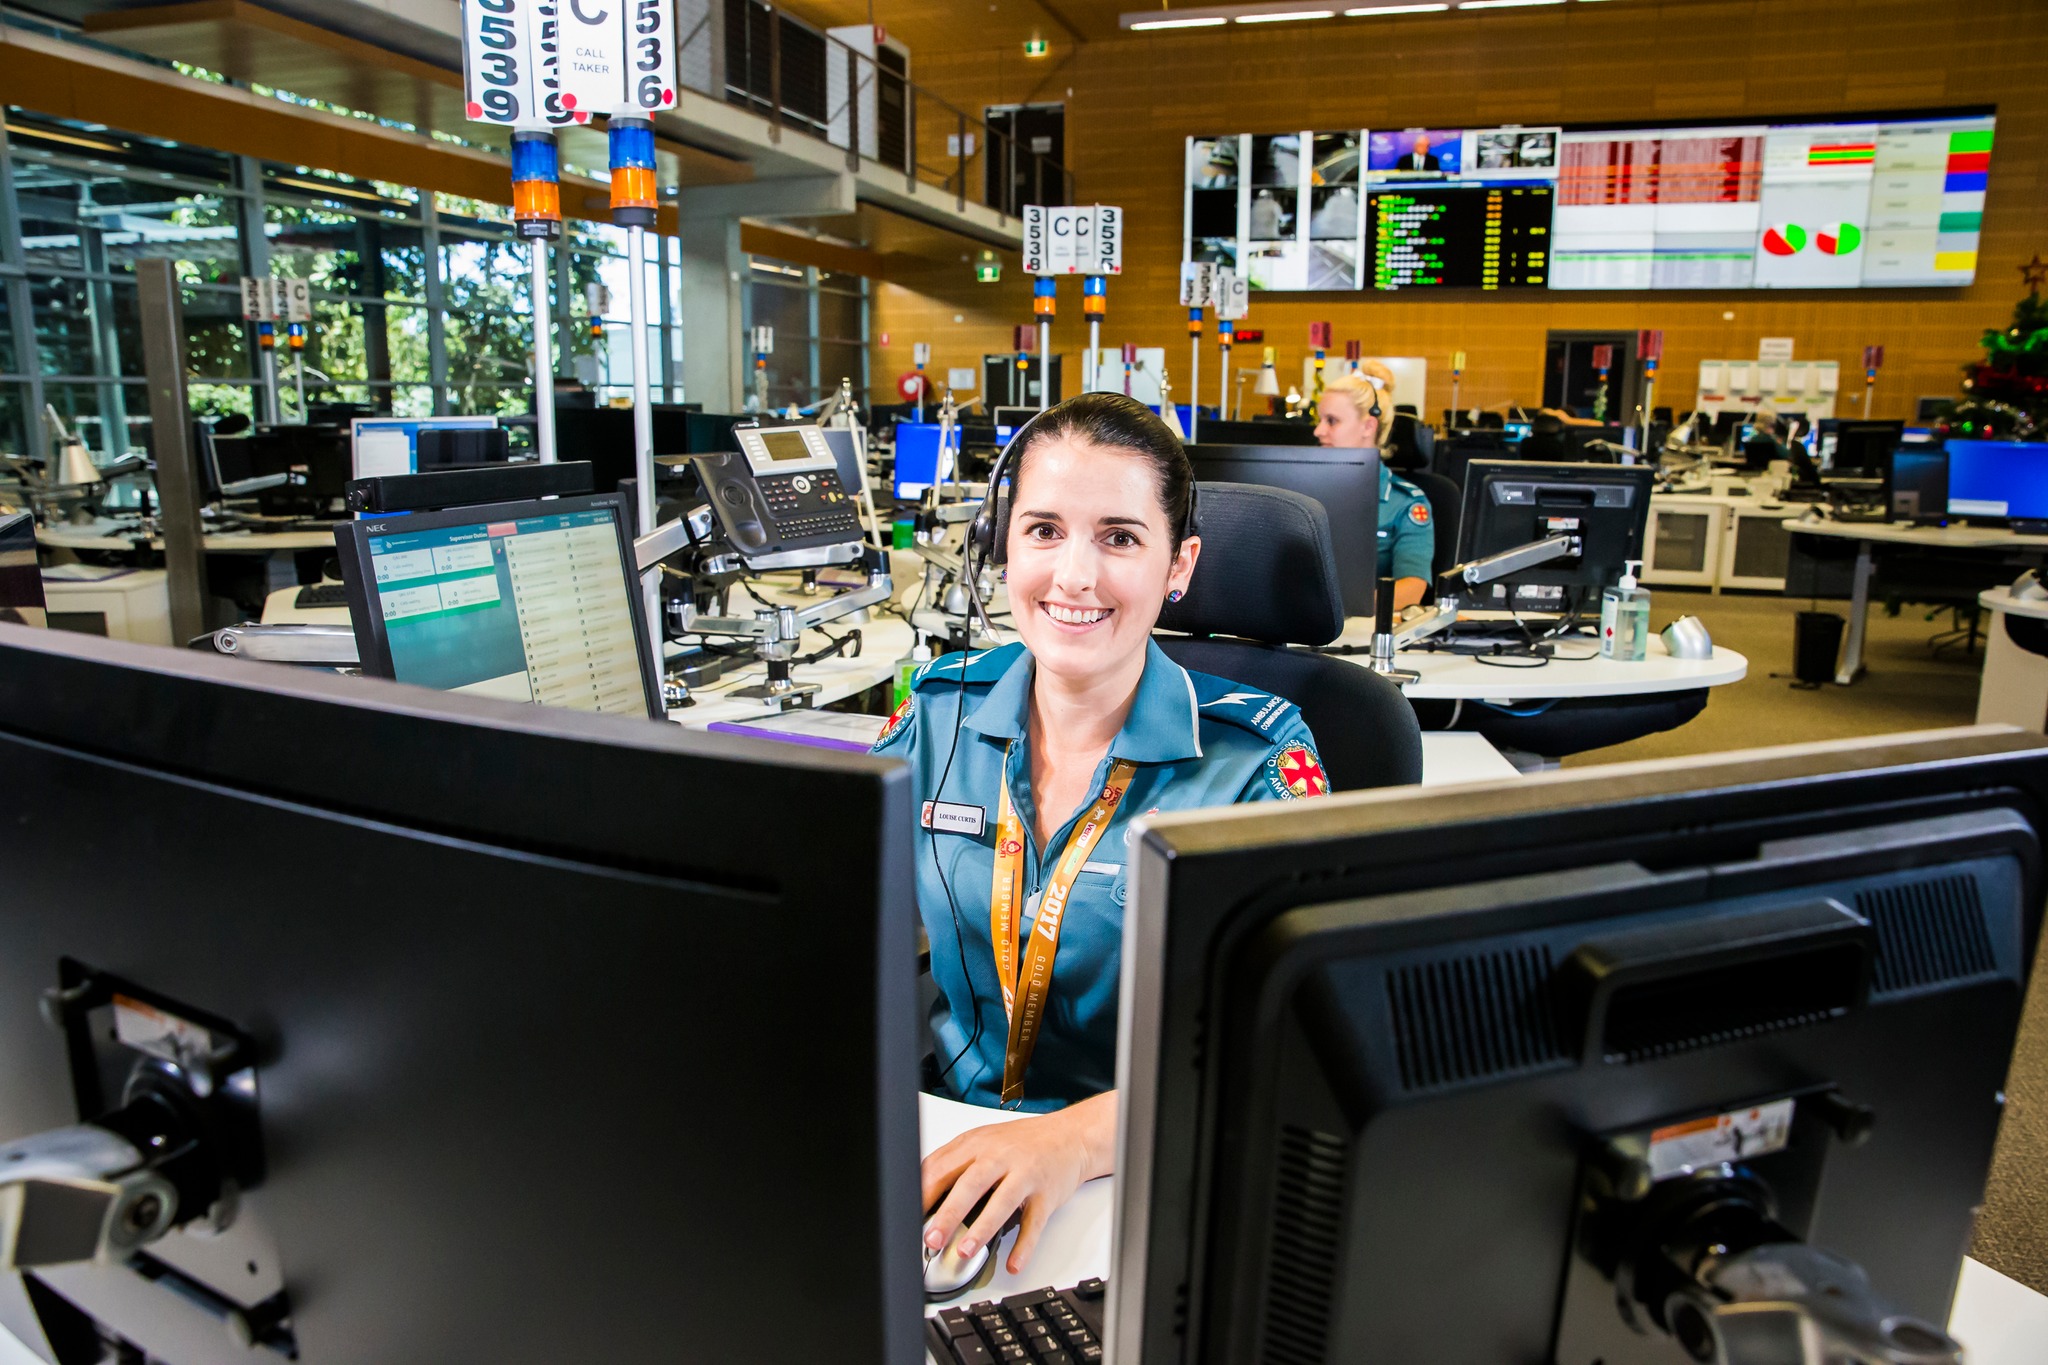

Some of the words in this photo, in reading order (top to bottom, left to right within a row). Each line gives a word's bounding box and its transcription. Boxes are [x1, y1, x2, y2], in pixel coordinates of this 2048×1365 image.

[575, 47, 606, 60] CALL
[573, 62, 610, 75] TAKER
[1054, 216, 1070, 236] C
[1030, 209, 1041, 271] 3538
[366, 523, 388, 533] NEC
[449, 533, 473, 543] Supervisor
[473, 532, 488, 541] Duties
[1251, 695, 1283, 726] AMBULANCE
[939, 813, 958, 821] LOUISE
[957, 815, 977, 824] CURTIS
[1080, 822, 1096, 842] vero
[1001, 876, 1012, 932] MEMBER
[1037, 881, 1068, 943] 2017
[1002, 939, 1010, 971] GOLD
[1031, 955, 1046, 987] GOLD
[1021, 992, 1039, 1042] MEMBER
